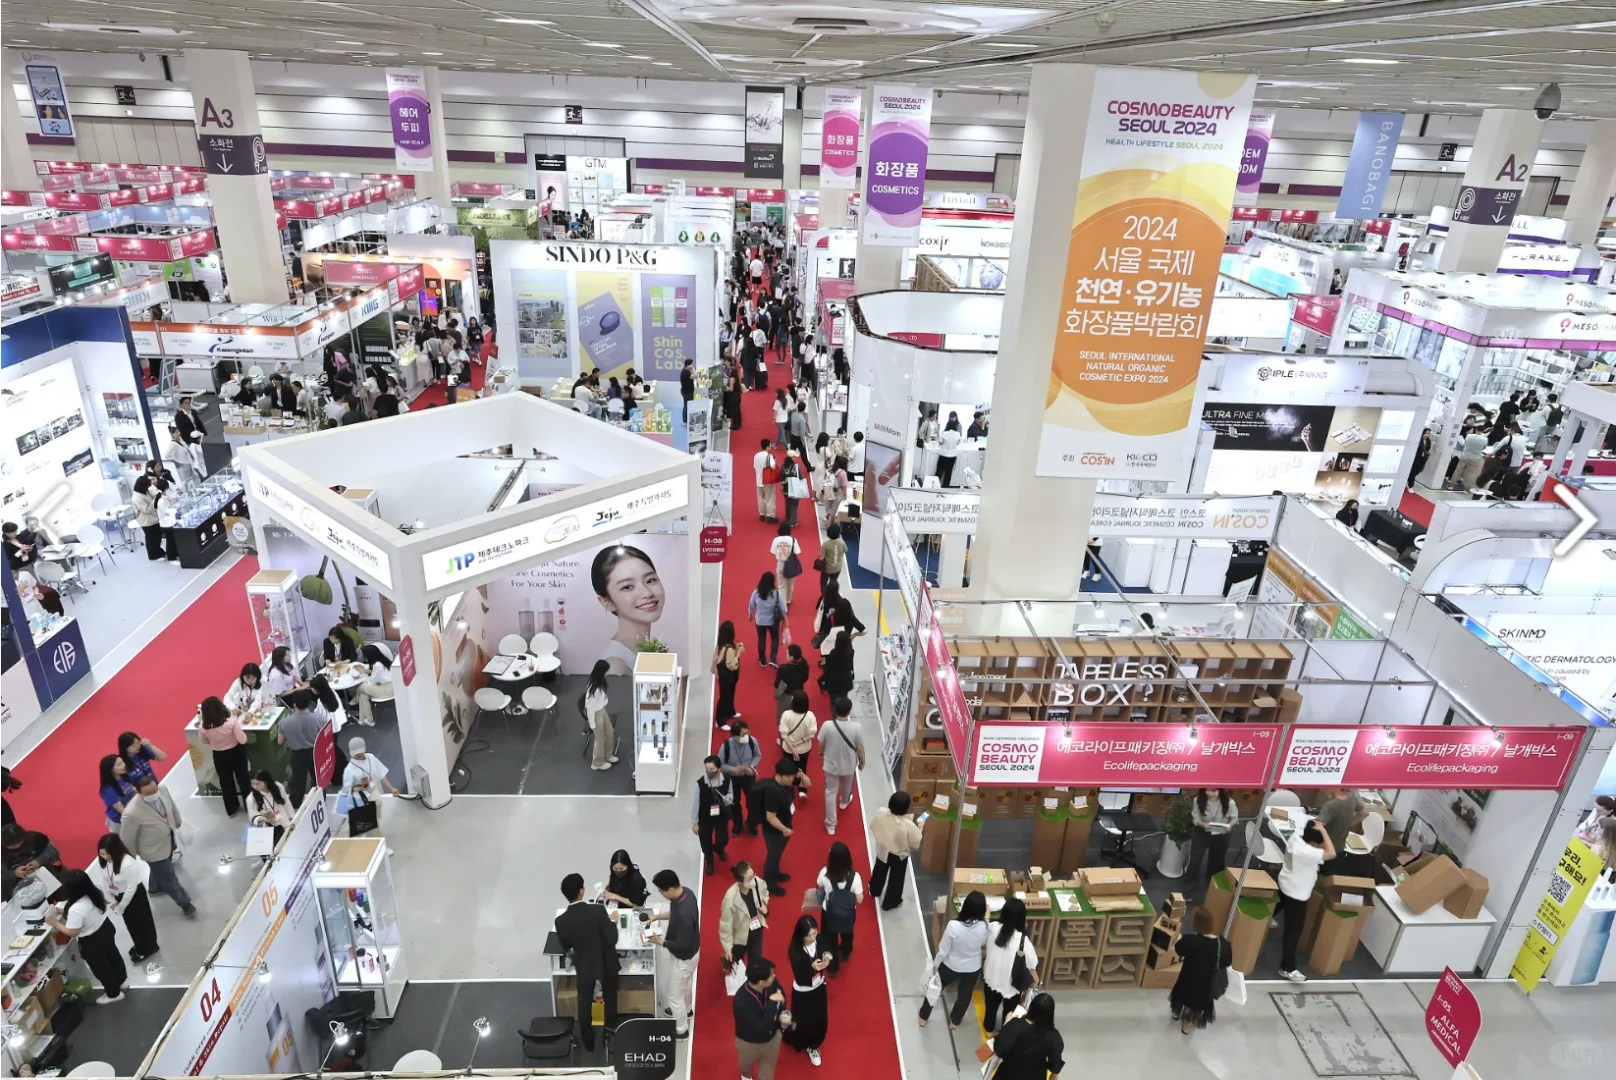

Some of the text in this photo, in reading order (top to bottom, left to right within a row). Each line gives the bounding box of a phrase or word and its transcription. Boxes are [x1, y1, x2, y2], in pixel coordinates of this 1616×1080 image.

[880, 96, 926, 104] COSMOBEAUTY
[201, 98, 234, 129] A3
[399, 108, 419, 119] 헤어
[1108, 100, 1235, 120] COSMOBEAUTY
[400, 122, 420, 133] 두피
[1118, 118, 1217, 136] SEOUL 2024
[209, 138, 234, 148] 소화전
[827, 134, 854, 145] 화장품
[1106, 138, 1134, 146] HEALTH
[1136, 140, 1174, 148] LIFESTYLE
[1175, 141, 1200, 149] SEOUL
[585, 158, 607, 168] GTM
[1360, 121, 1394, 210] BANOBAGI
[1495, 154, 1528, 182] A2
[875, 161, 919, 178] 화장품
[872, 184, 919, 195] COSMETICS
[1494, 191, 1516, 202] 소화전
[1123, 215, 1178, 241] 2024
[546, 246, 657, 266] SINDO P&G
[1094, 247, 1195, 275] 서울 국제
[1076, 277, 1202, 308] 천연·유기농
[1064, 308, 1203, 339] 화장품박람회
[654, 336, 682, 347] Shin
[1080, 351, 1175, 362] SEOUL INTERNATIONAL
[656, 359, 683, 370] Lab
[1086, 362, 1166, 373] NATURAL ORGANIC
[1080, 373, 1169, 383] COSMETIC EXPO 2024
[477, 536, 529, 558] 제주테크노파크
[445, 552, 475, 575] JTP
[528, 580, 546, 588] Your
[548, 580, 566, 588] Skin
[1498, 629, 1546, 638] SKINMD
[1056, 663, 1167, 680] TAPELESS
[1054, 684, 1133, 705] BOX
[982, 743, 1039, 752] COSMO
[1201, 743, 1255, 756] 날개박스
[1292, 746, 1348, 755] COSMO
[1504, 744, 1557, 757] 날개박스
[981, 755, 1036, 763] BEAUTY
[1289, 756, 1344, 765] BEAUTY
[1103, 760, 1198, 772] Ecolifepackaging
[1406, 762, 1498, 774] Ecolifepackaging
[310, 800, 325, 834] 06
[261, 883, 279, 918] 05
[200, 977, 222, 1023] 04
[1441, 1015, 1459, 1039] ALFA
[203, 1040, 215, 1058] Skin
[214, 1014, 230, 1040] Repair
[1430, 1016, 1461, 1055] MEDICAL
[625, 1053, 666, 1062] EHAD
